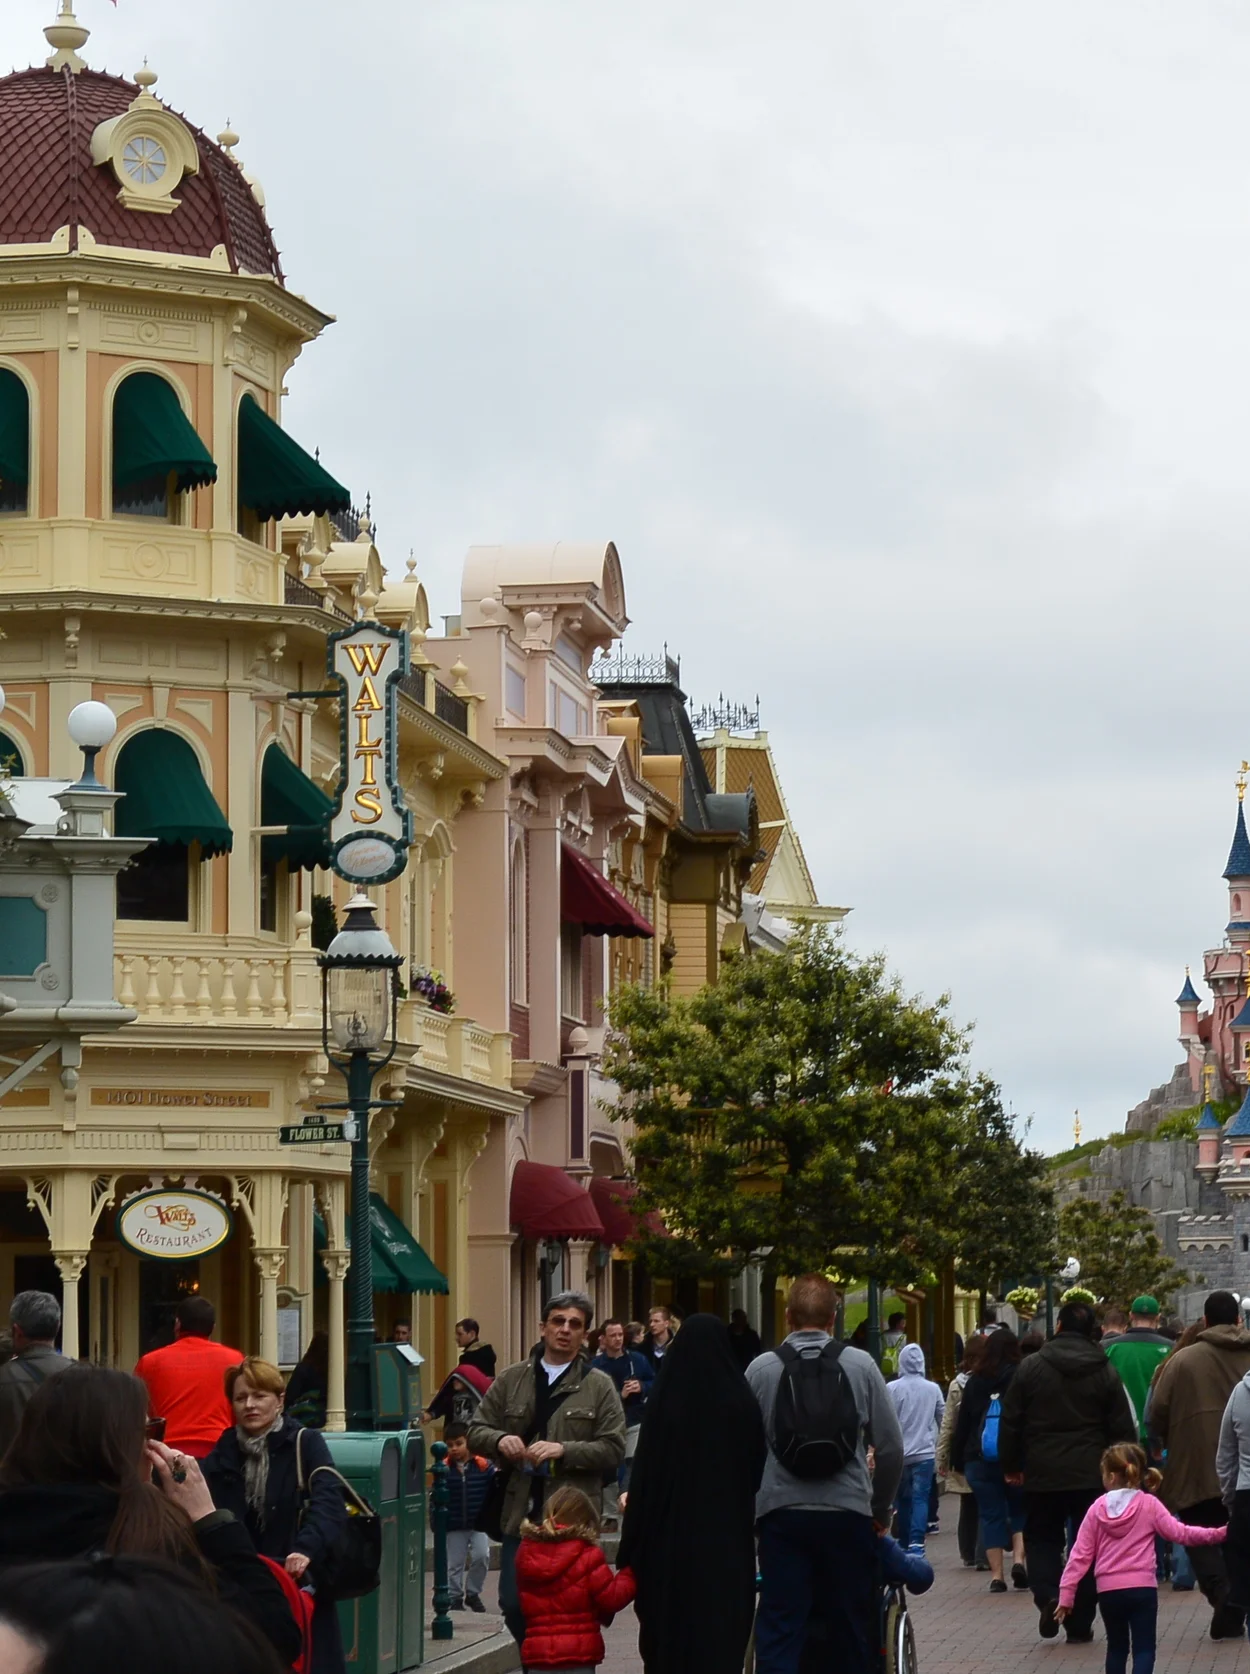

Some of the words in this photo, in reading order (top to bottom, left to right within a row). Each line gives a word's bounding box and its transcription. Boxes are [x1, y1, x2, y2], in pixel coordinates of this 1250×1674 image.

[341, 642, 391, 825] WALTS
[203, 1093, 252, 1107] Street
[289, 1127, 325, 1141] FLOWER
[326, 1126, 340, 1138] ST.
